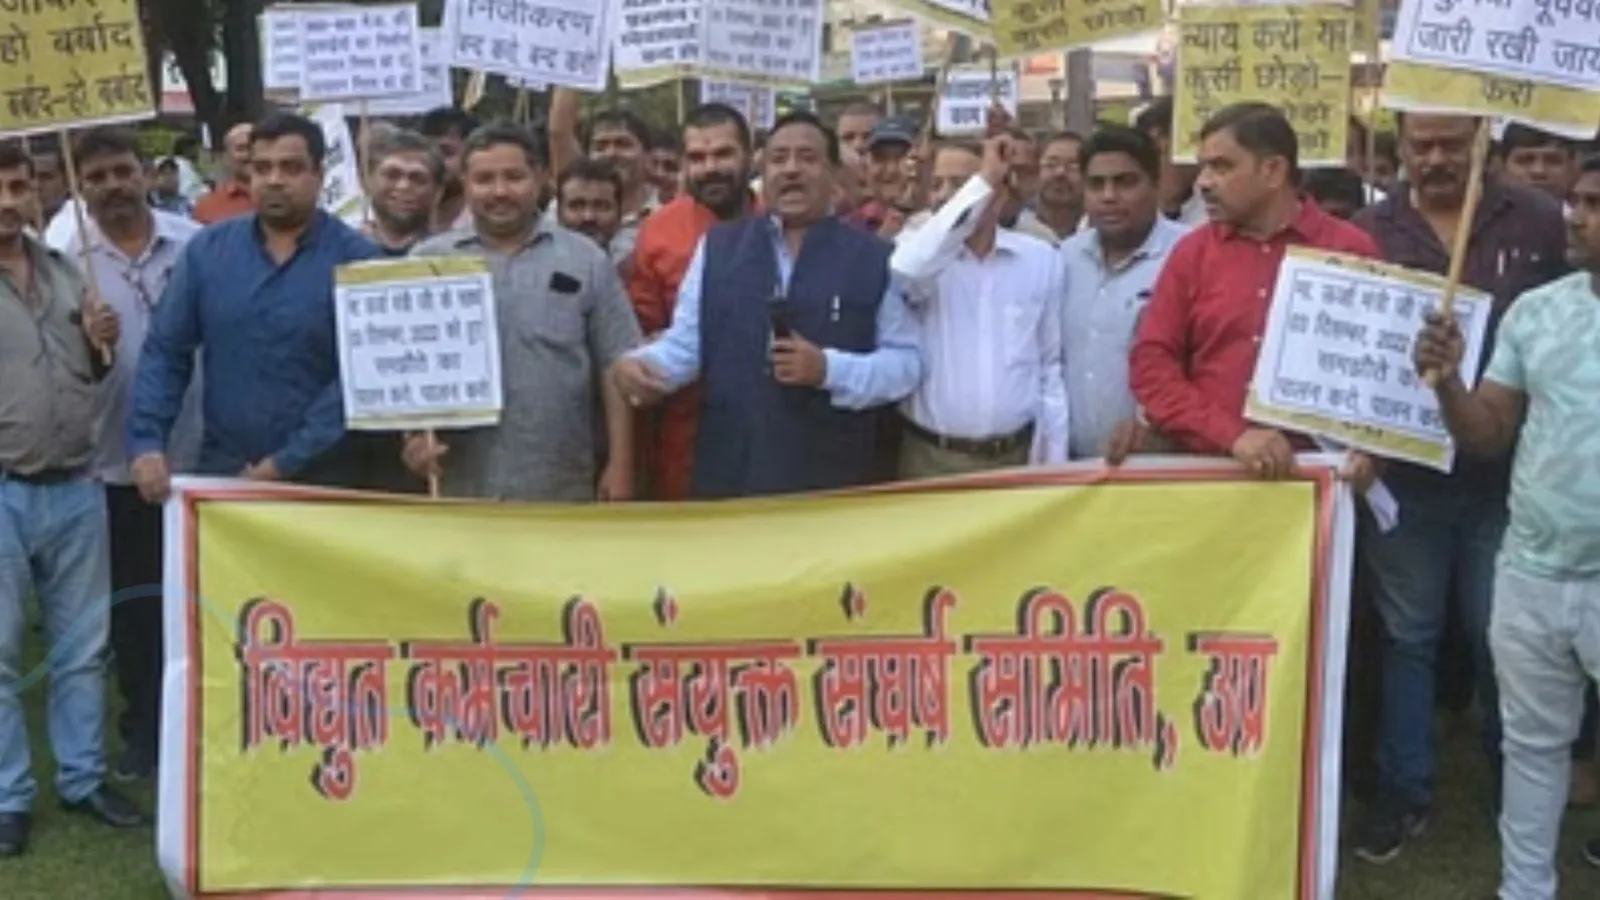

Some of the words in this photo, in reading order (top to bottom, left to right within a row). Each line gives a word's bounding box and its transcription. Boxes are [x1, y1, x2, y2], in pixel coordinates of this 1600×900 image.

[1182, 22, 1240, 52] न्याय
[1418, 17, 1473, 55] जारी
[1486, 26, 1538, 64] रखी
[235, 597, 395, 802] विद्युत
[401, 595, 617, 752] कर्मचारी
[621, 585, 802, 800] संयुक्त
[807, 581, 957, 752] संघर्ष
